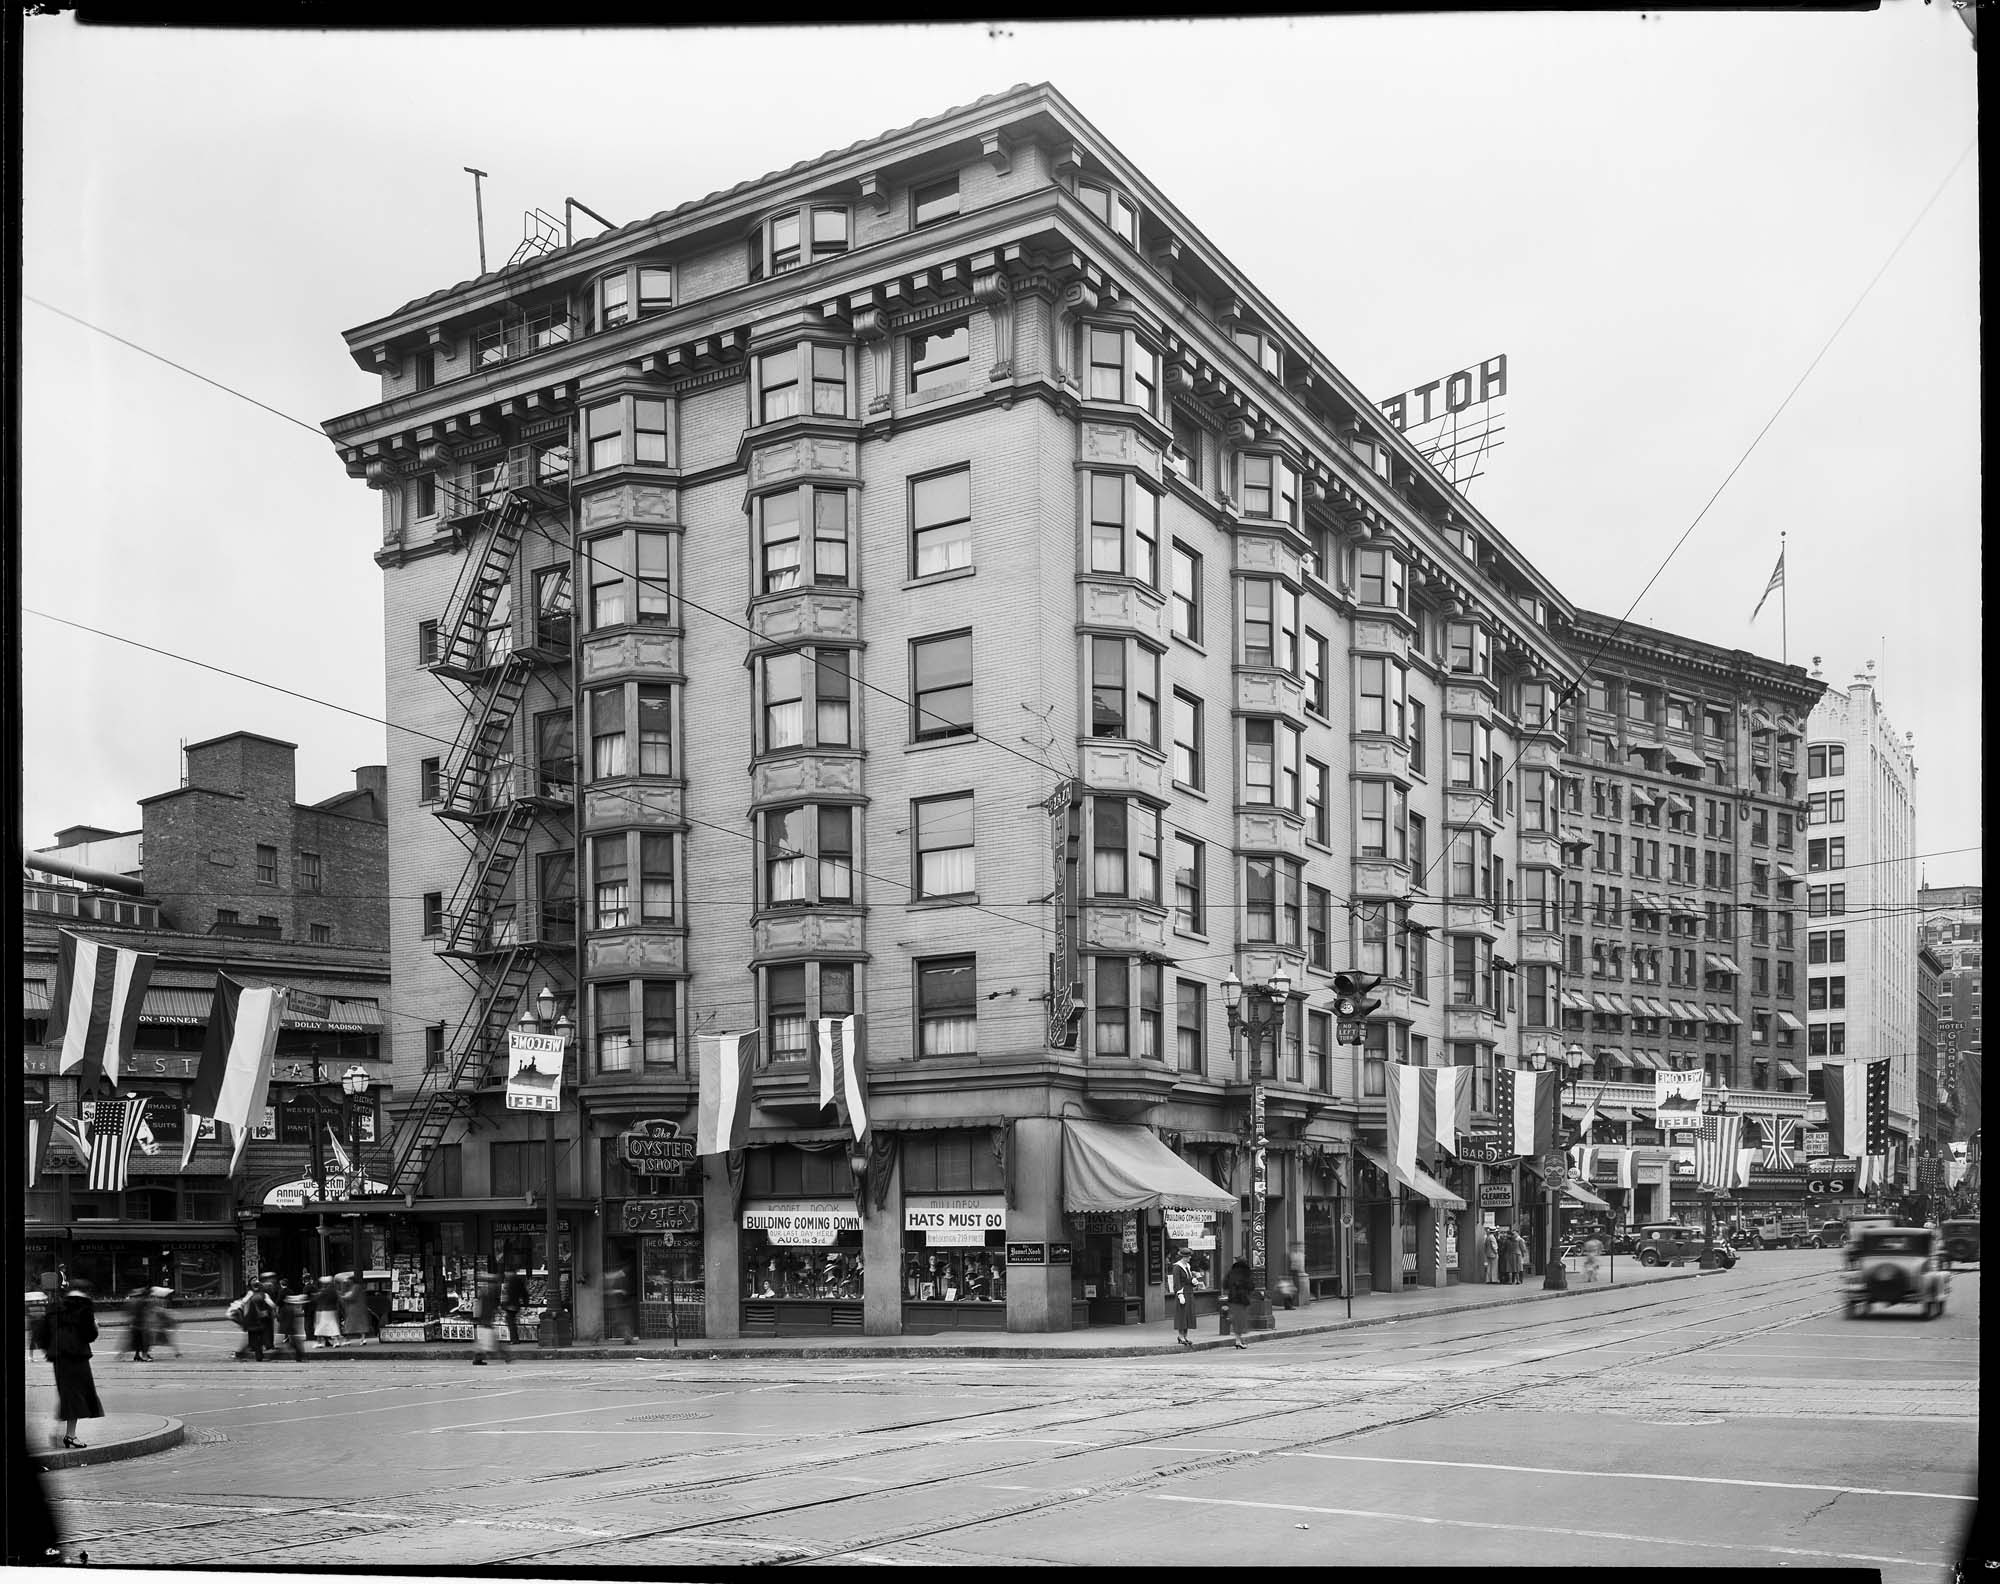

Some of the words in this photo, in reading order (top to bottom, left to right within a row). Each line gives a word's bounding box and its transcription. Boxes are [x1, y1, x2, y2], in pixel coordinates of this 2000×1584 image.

[1056, 814, 1065, 998] HOTEL
[294, 1021, 321, 1029] DOLLY
[328, 1023, 363, 1031] MADISON
[1948, 1032, 1956, 1089] GEORGIAN
[653, 1127, 671, 1138] The
[630, 1139, 695, 1160] OYSTER
[1485, 1141, 1498, 1162] 5
[646, 1158, 680, 1171] SHOP
[276, 1189, 307, 1198] ANNUAL
[1481, 1192, 1511, 1200] CLEANERS
[628, 1205, 692, 1228] OYSTER
[655, 1219, 683, 1228] SHOP
[746, 1215, 792, 1229] BUILDING
[794, 1216, 830, 1230] COMING
[833, 1216, 861, 1230] DOWN
[909, 1213, 945, 1226] HATS
[949, 1213, 982, 1227] MUST
[985, 1214, 1002, 1227] GO
